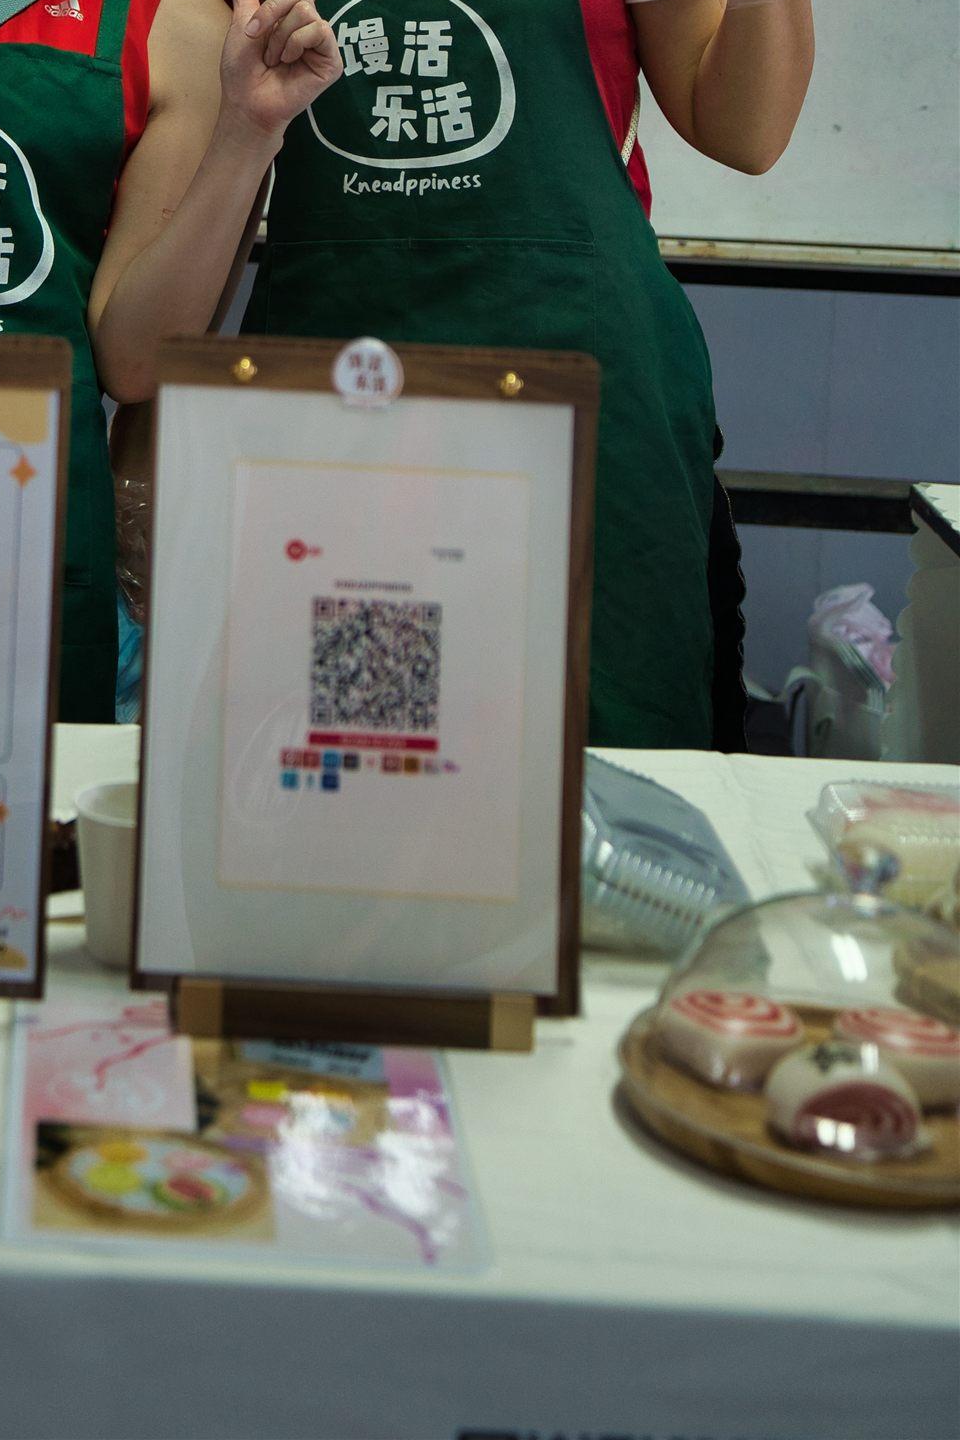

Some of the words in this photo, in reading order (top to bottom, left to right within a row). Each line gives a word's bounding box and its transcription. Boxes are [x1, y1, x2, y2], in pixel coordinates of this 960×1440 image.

[44, 4, 84, 22] adidas
[337, 17, 453, 77] 馒活
[370, 81, 475, 144] 乐活
[342, 171, 482, 196] Kneadppiness
